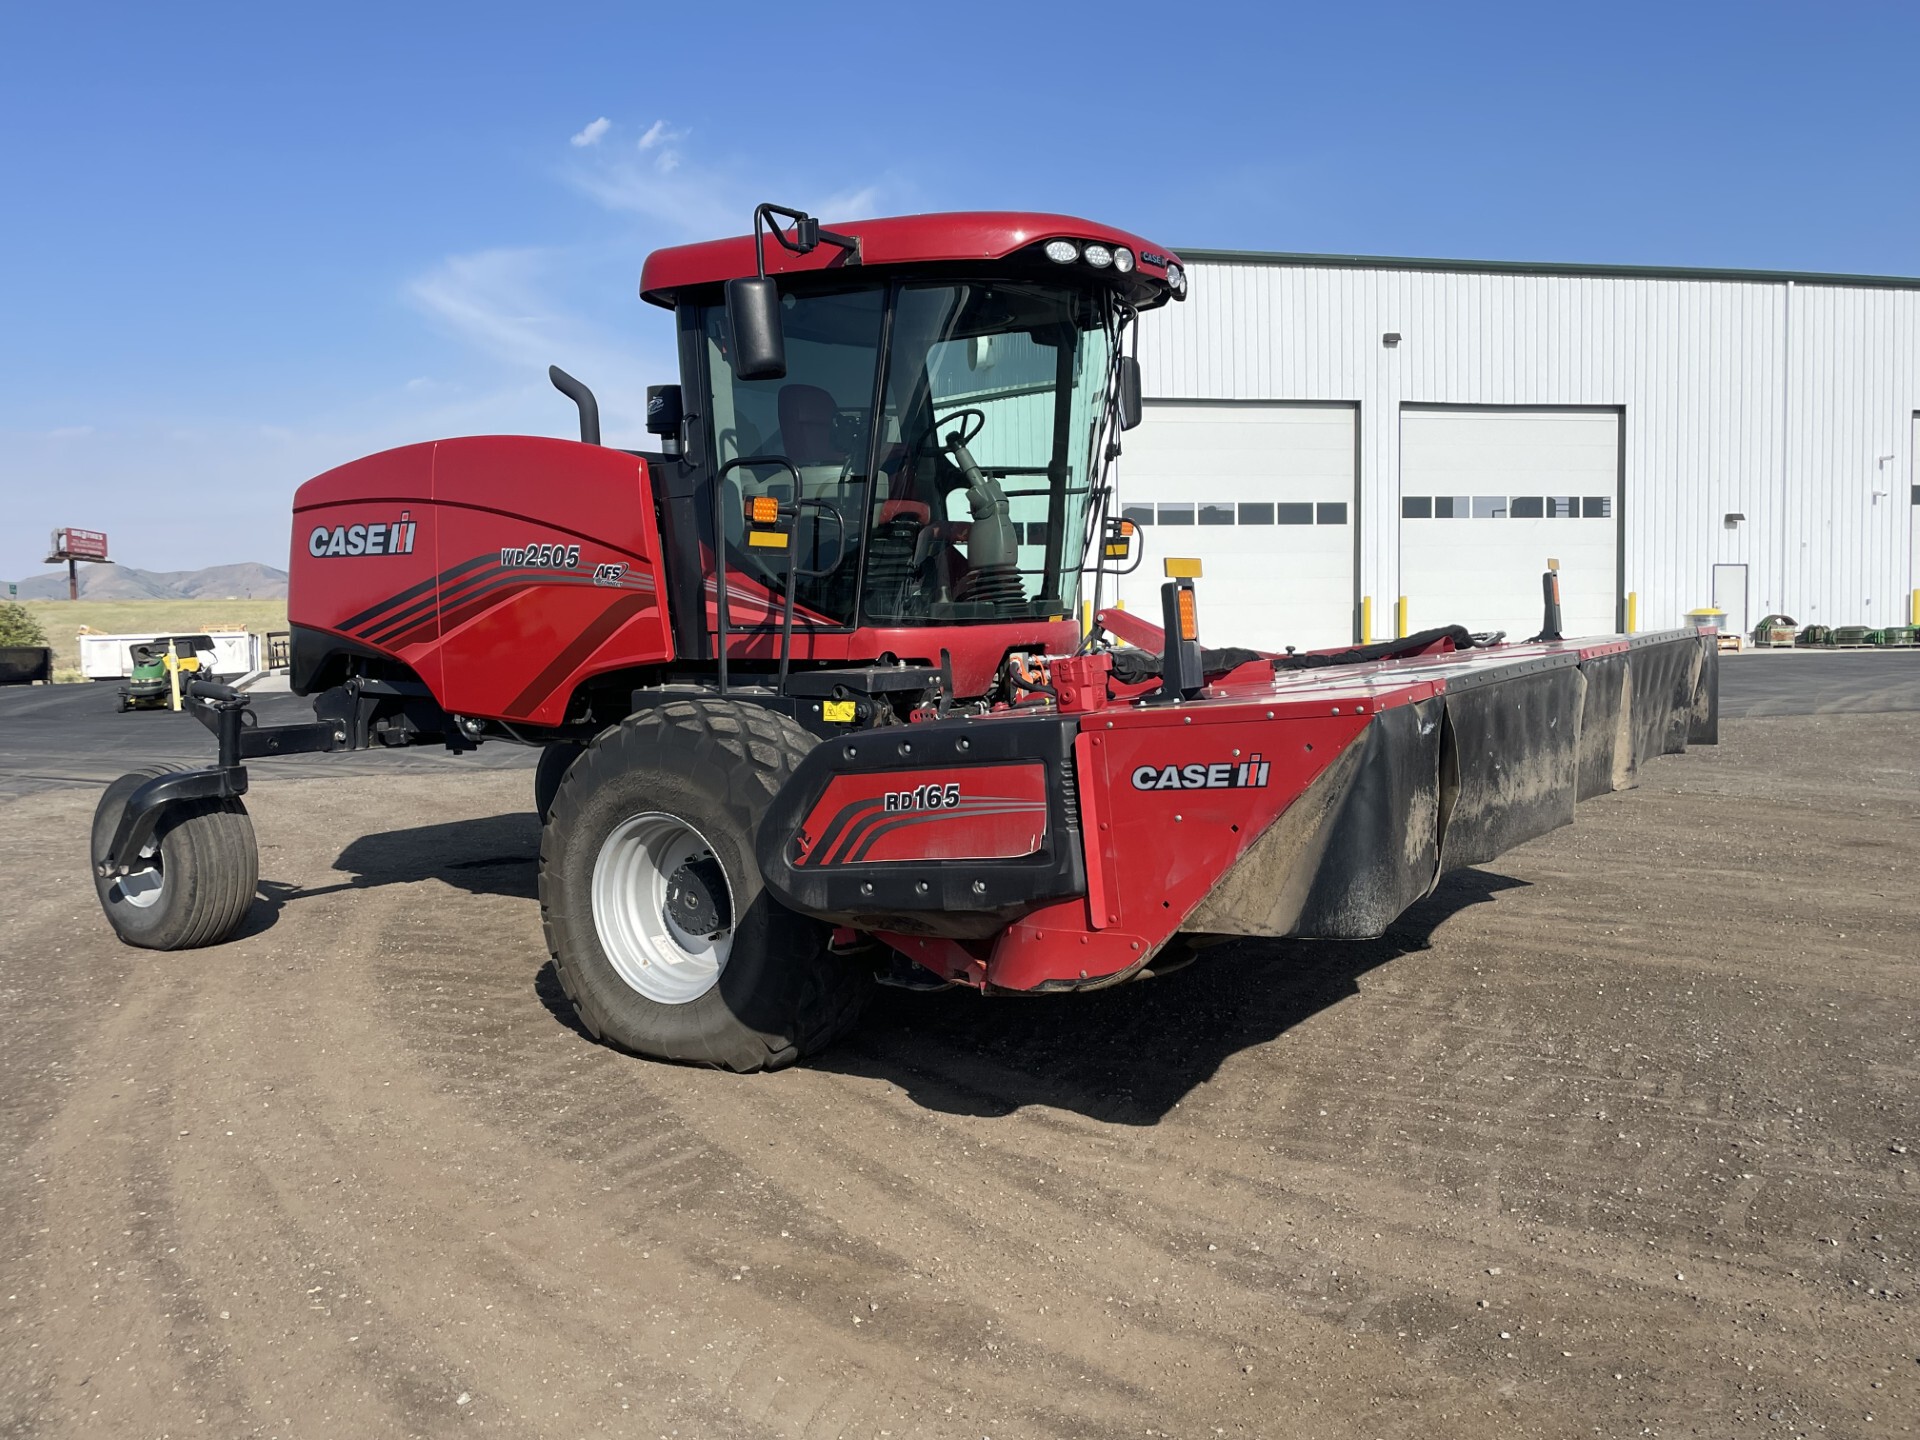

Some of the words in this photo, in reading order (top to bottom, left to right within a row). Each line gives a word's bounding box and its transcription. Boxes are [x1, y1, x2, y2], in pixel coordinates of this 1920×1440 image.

[1143, 252, 1161, 264] CASE
[309, 524, 386, 557] CASE
[501, 543, 580, 569] WD2505
[593, 563, 622, 580] AFS
[1132, 764, 1232, 790] CASE
[884, 783, 960, 812] RD165
